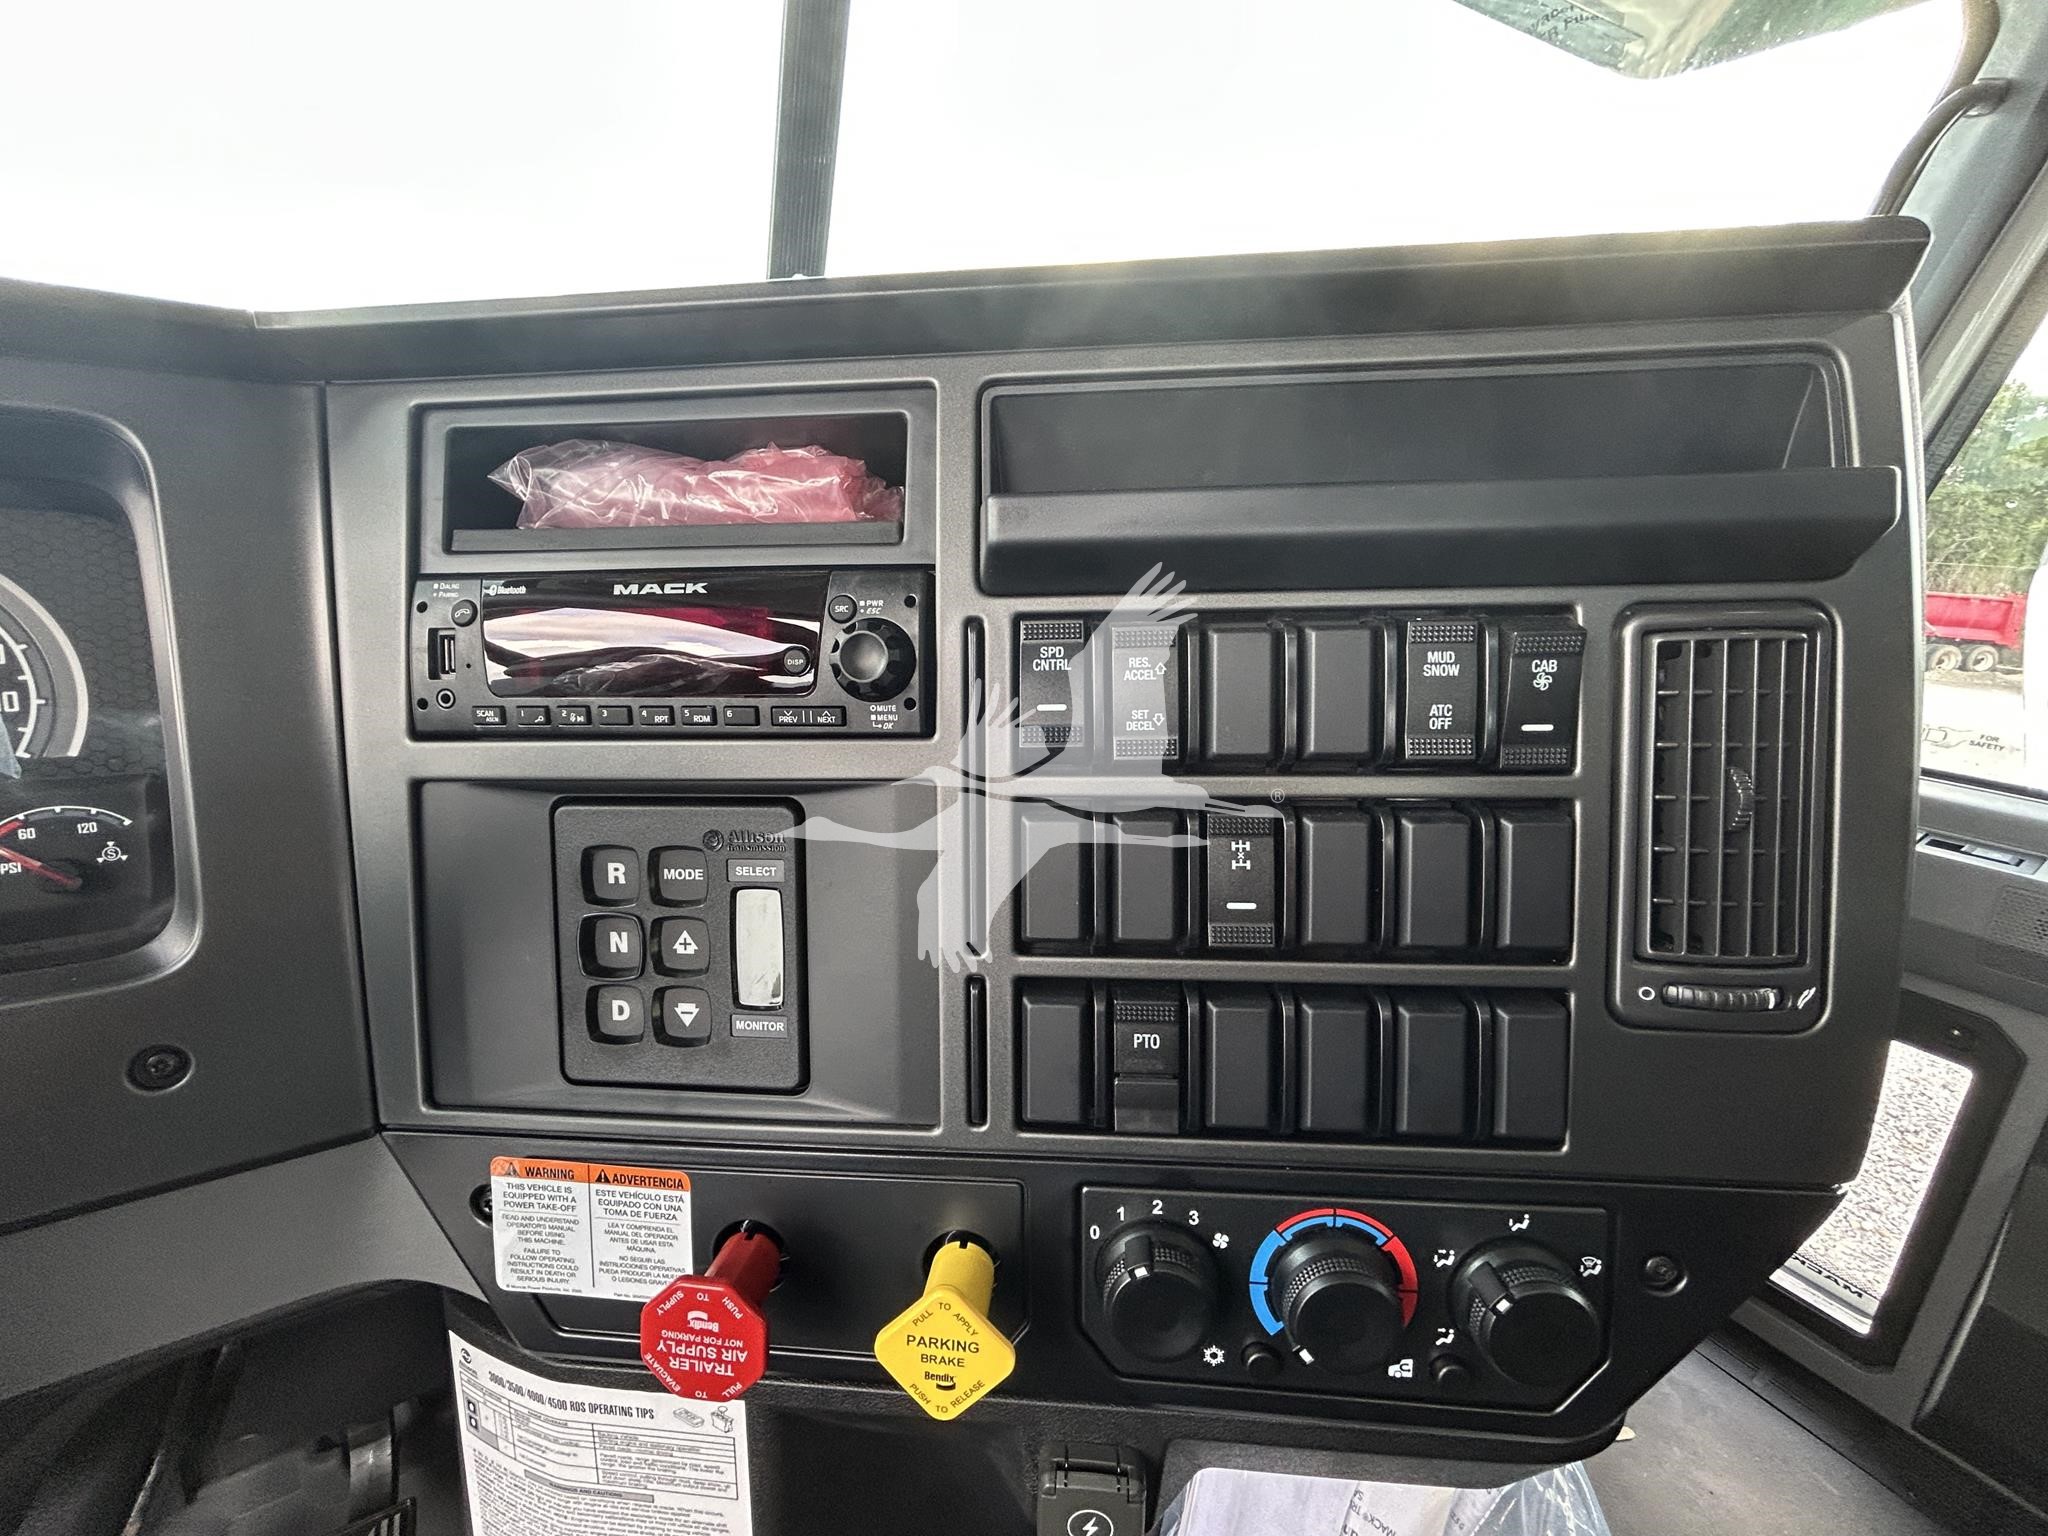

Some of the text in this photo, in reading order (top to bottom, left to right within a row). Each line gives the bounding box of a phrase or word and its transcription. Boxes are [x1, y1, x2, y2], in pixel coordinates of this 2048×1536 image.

[613, 583, 708, 595] MACK
[834, 605, 849, 613] SRC
[1040, 646, 1065, 659] SPD
[1427, 651, 1455, 663] MUD
[1033, 658, 1072, 671] CNTRL
[1128, 657, 1151, 668] RES.
[1532, 659, 1558, 673] CAB
[1124, 669, 1157, 681] ACCEL
[1423, 664, 1460, 677] SNOW
[684, 709, 690, 717] 5
[727, 710, 733, 718] 6
[1131, 709, 1149, 720] SET
[1429, 704, 1453, 717] ATC
[654, 715, 669, 723] RPT
[694, 715, 711, 723] RDM
[1126, 720, 1155, 731] DECEL
[1429, 717, 1453, 730] OFF
[1969, 740, 2005, 751] SAFETY
[17, 828, 36, 839] 60
[77, 821, 98, 834] 120
[727, 830, 786, 844] Allison
[0, 862, 22, 874] PSI
[607, 862, 626, 884] R
[663, 868, 704, 881] MODE
[735, 866, 777, 877] SELECT
[609, 931, 628, 953] N
[612, 1000, 631, 1021] D
[735, 1020, 785, 1032] MONITOR
[1133, 1033, 1160, 1049] PTO
[524, 1166, 575, 1180] WARNING
[612, 1174, 684, 1189] ADVERTENCIA
[527, 1184, 562, 1193] VEHICLE
[503, 1191, 546, 1200] EQUIPPED
[547, 1195, 569, 1203] WITH
[596, 1189, 684, 1204] ESTE VEHÍCULO ESTÁ
[503, 1200, 577, 1212] POWER TAKE-OFF
[598, 1199, 682, 1213] EQUIPADO CON UNA
[1152, 1200, 1163, 1215] 2
[603, 1208, 678, 1221] TOMA DE FUERZA
[1116, 1207, 1125, 1221] 1
[1188, 1210, 1200, 1226] 3
[1089, 1224, 1101, 1240] 0
[656, 1290, 744, 1320] PUSH TO SUPPLY
[687, 1319, 720, 1333] Bendix
[911, 1302, 980, 1337] PULL TO APPLY
[661, 1329, 744, 1347] NOT FOR PARKING
[906, 1334, 980, 1354] PARKING
[656, 1339, 748, 1362] AIR SUPPLY
[668, 1356, 735, 1376] TRAILER
[920, 1353, 965, 1368] BRAKE
[644, 1352, 743, 1399] PULL TO EVACUATE
[924, 1371, 955, 1383] Bendix
[909, 1380, 986, 1414] PUSH TO RELEASE
[588, 1402, 633, 1418] OPERATING
[635, 1406, 655, 1420] TIPS
